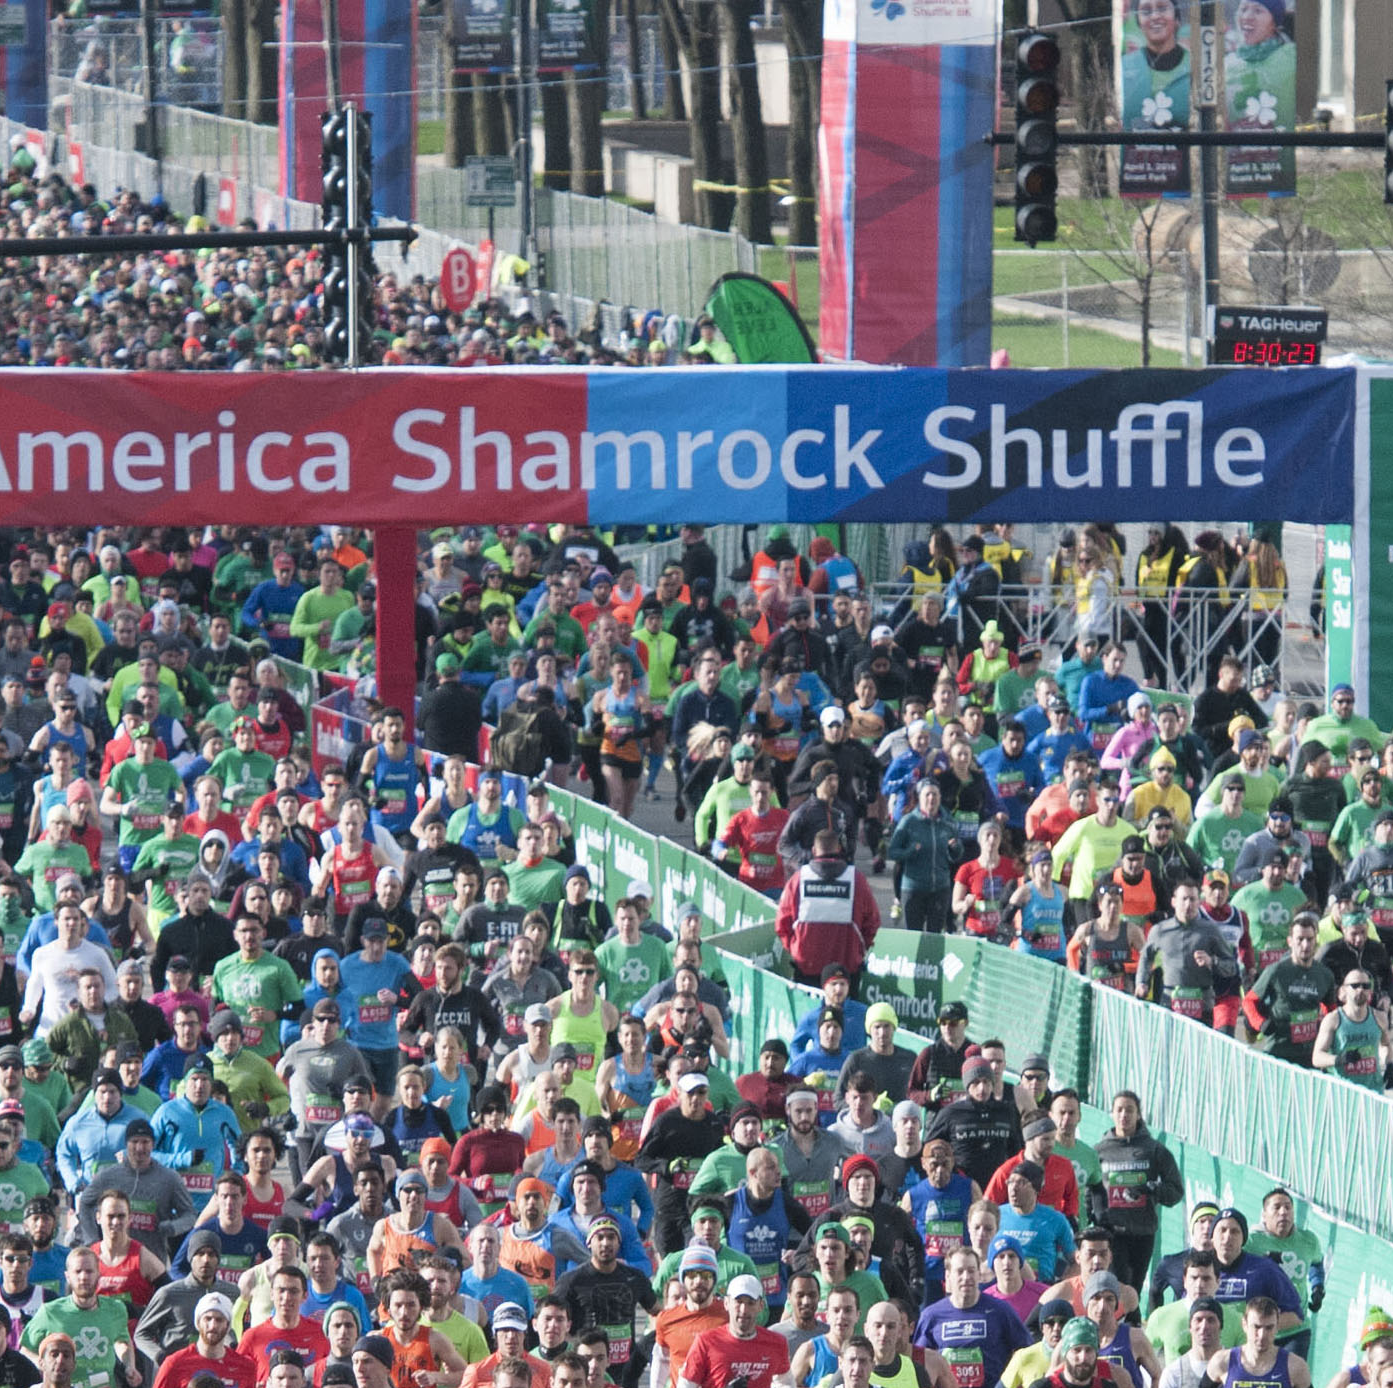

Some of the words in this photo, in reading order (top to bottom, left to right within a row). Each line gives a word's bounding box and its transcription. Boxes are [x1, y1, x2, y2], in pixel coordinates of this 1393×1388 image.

[1124, 162, 1146, 175] April
[450, 251, 471, 295] B
[391, 404, 885, 491] Shamrock
[922, 399, 1266, 489] Shuffle
[806, 884, 849, 895] SECURITY
[731, 1362, 750, 1370] FLEET
[752, 1362, 770, 1370] FEET
